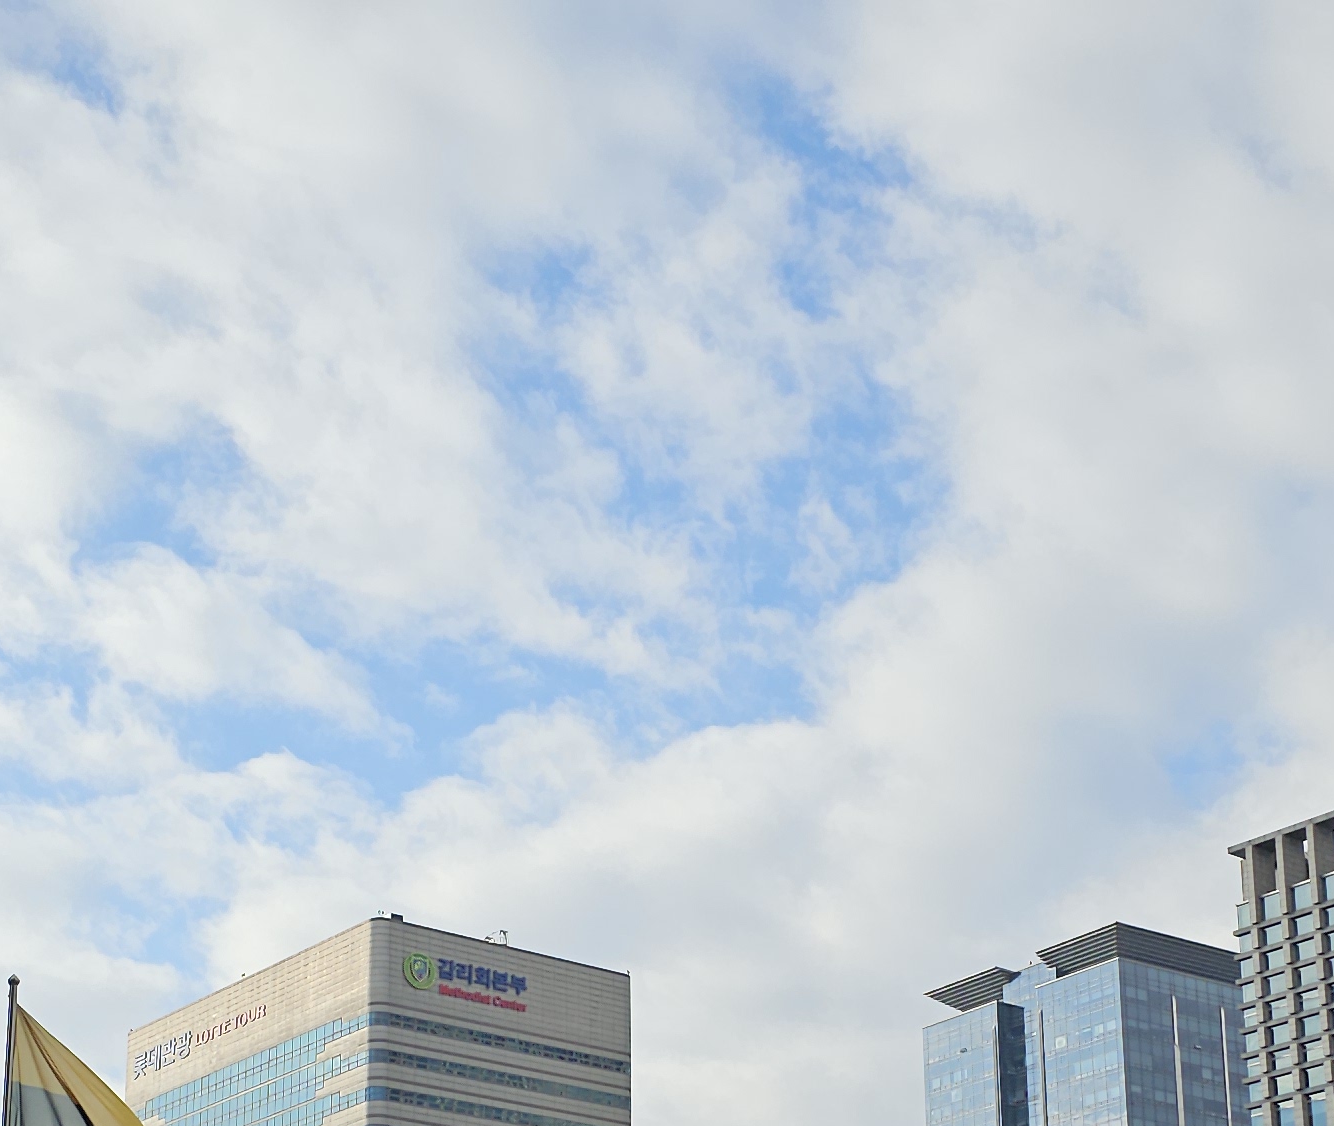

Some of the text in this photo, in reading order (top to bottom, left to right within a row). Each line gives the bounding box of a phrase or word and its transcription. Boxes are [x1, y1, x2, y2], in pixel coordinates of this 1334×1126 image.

[438, 958, 527, 996] 감리회본부
[134, 1004, 267, 1080] 롯데관광 LOTTE TOUR
